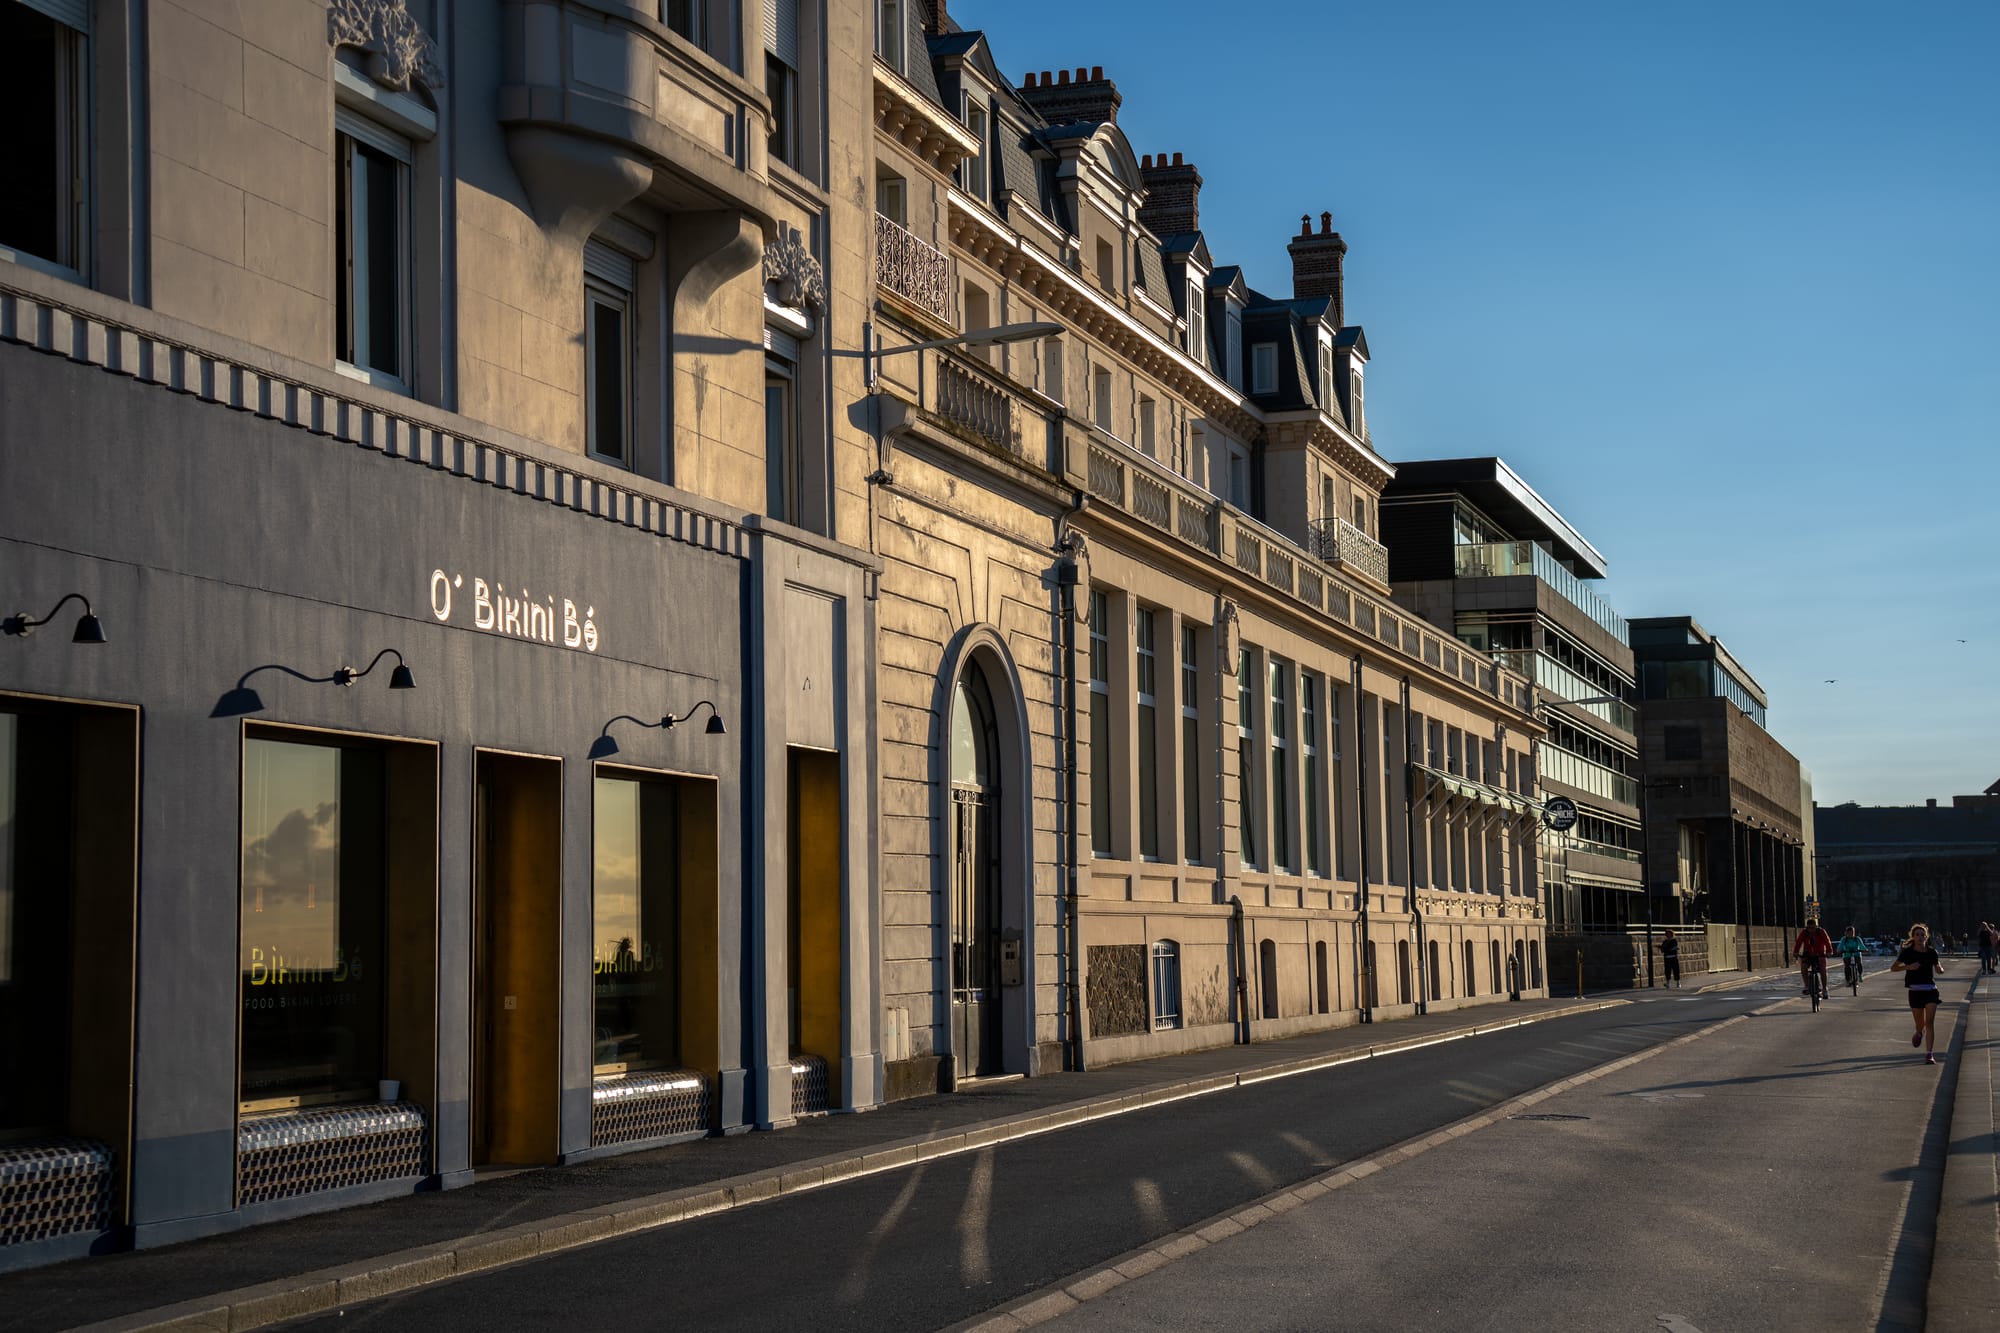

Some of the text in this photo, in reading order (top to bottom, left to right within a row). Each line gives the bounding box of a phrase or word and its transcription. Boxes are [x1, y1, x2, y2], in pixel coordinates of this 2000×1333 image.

[474, 577, 554, 643] Bikini
[564, 598, 598, 652] Bé
[251, 945, 322, 985] Bikini
[245, 998, 274, 1009] FOOD
